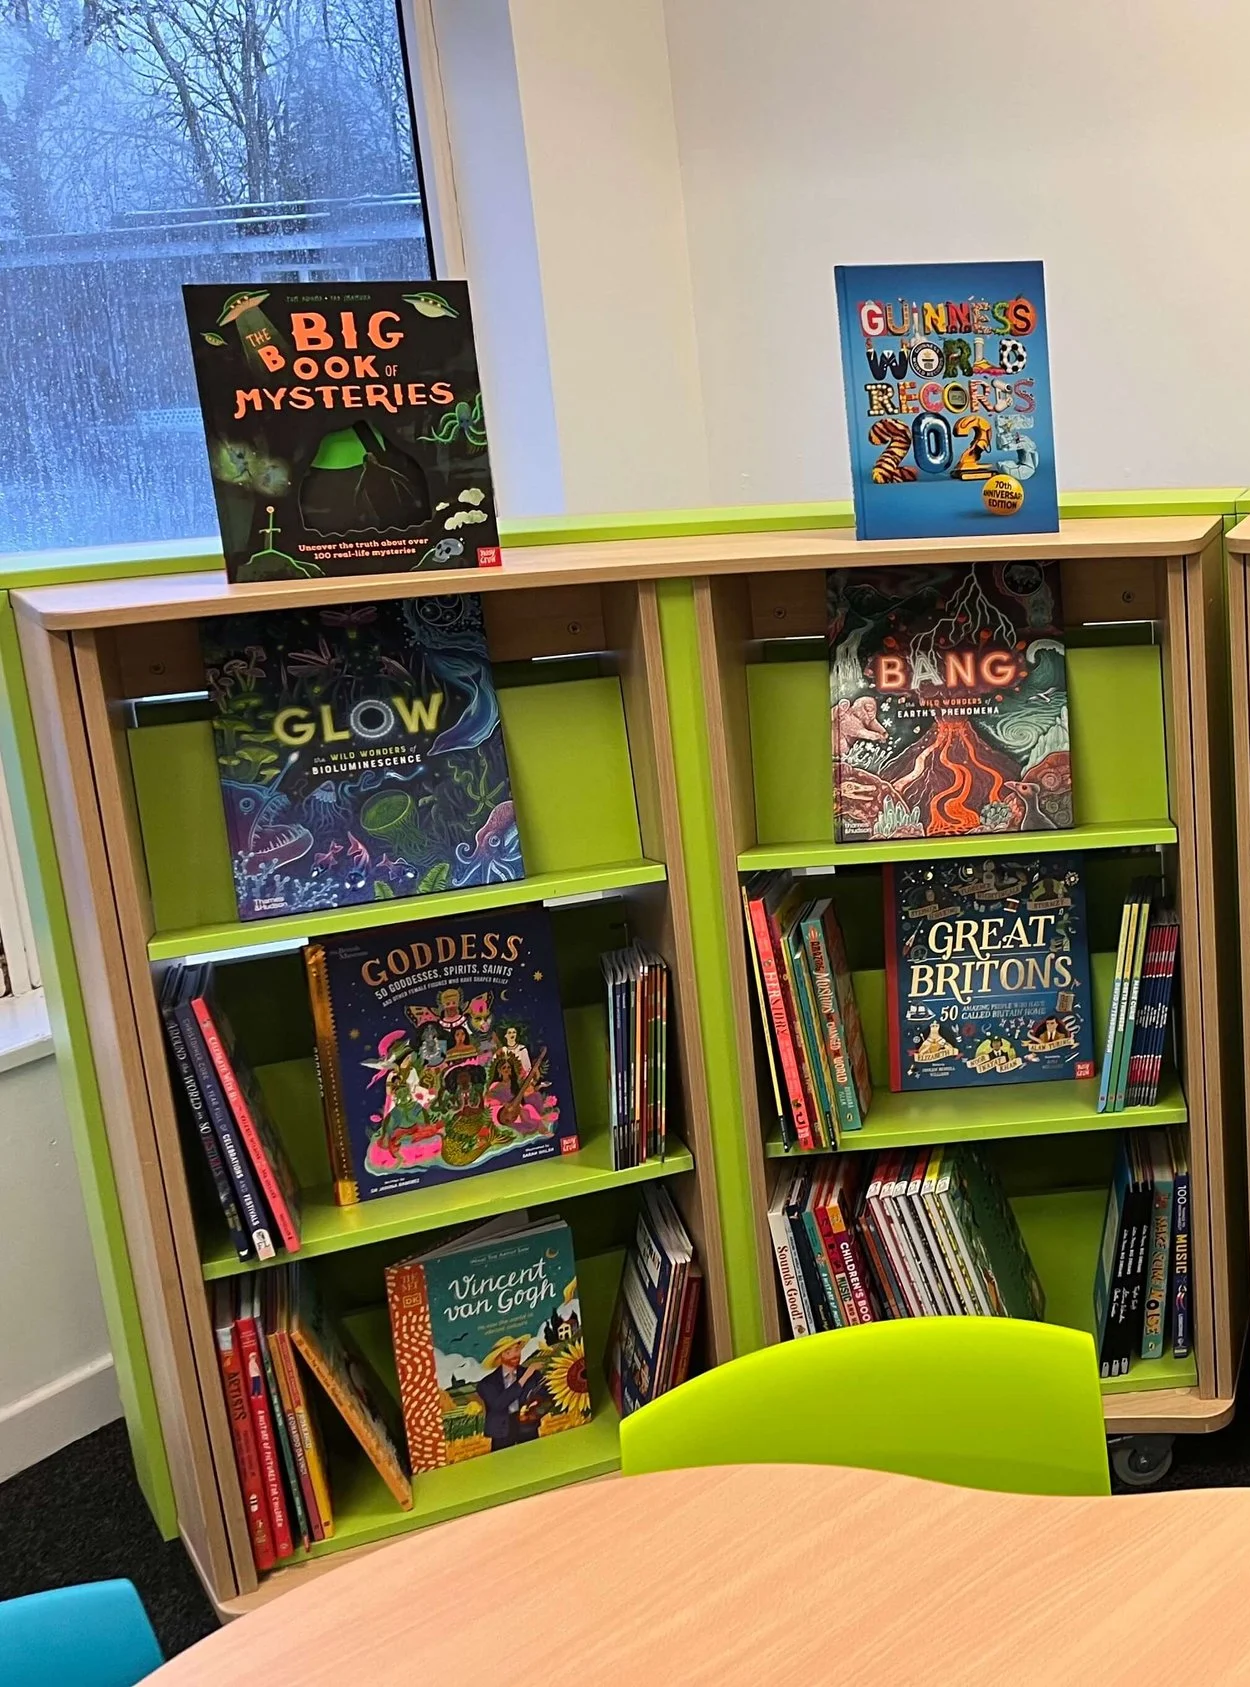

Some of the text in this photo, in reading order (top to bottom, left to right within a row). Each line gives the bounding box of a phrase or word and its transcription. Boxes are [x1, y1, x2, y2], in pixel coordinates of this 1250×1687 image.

[291, 311, 404, 351] BIG
[858, 298, 1037, 336] GUINNESS
[246, 328, 271, 348] THE
[257, 345, 398, 380] BOOK OF
[866, 338, 1027, 380] WORLD
[234, 382, 454, 419] MYSTERIES
[866, 378, 1036, 416] RECORDS
[868, 413, 1039, 484] 2025
[988, 499, 1017, 509] EDITION
[995, 481, 1012, 490] 70th
[298, 537, 429, 552] Uncover the truth about over
[314, 547, 416, 560] 100 real-life mysteries
[880, 652, 1017, 689] BANG
[273, 691, 444, 746] GLOW
[897, 706, 999, 718] EARTH'S PHENOMENA
[312, 754, 422, 775] BIOLUMINESCENCE
[330, 751, 355, 761] WILD
[359, 745, 406, 758] WONDERS
[928, 915, 1055, 961] GREAT
[361, 932, 524, 987] GODDESS
[908, 953, 1072, 1004] BRITONS
[374, 963, 513, 1000] 50 GODDESSES, SPIRITS, SAINTS
[764, 970, 789, 1037] HERSTORY
[940, 1005, 959, 1022] 50
[961, 1007, 1047, 1020] CALLED BRITAIN HOME
[1174, 1184, 1187, 1273] 100 MUSIC
[448, 1257, 546, 1300] Vincent
[778, 1242, 804, 1321] Sounds Good!
[839, 1240, 864, 1299] CHILDREN'S
[444, 1278, 556, 1322] van Gogh
[224, 1371, 246, 1421] ARTISTS
